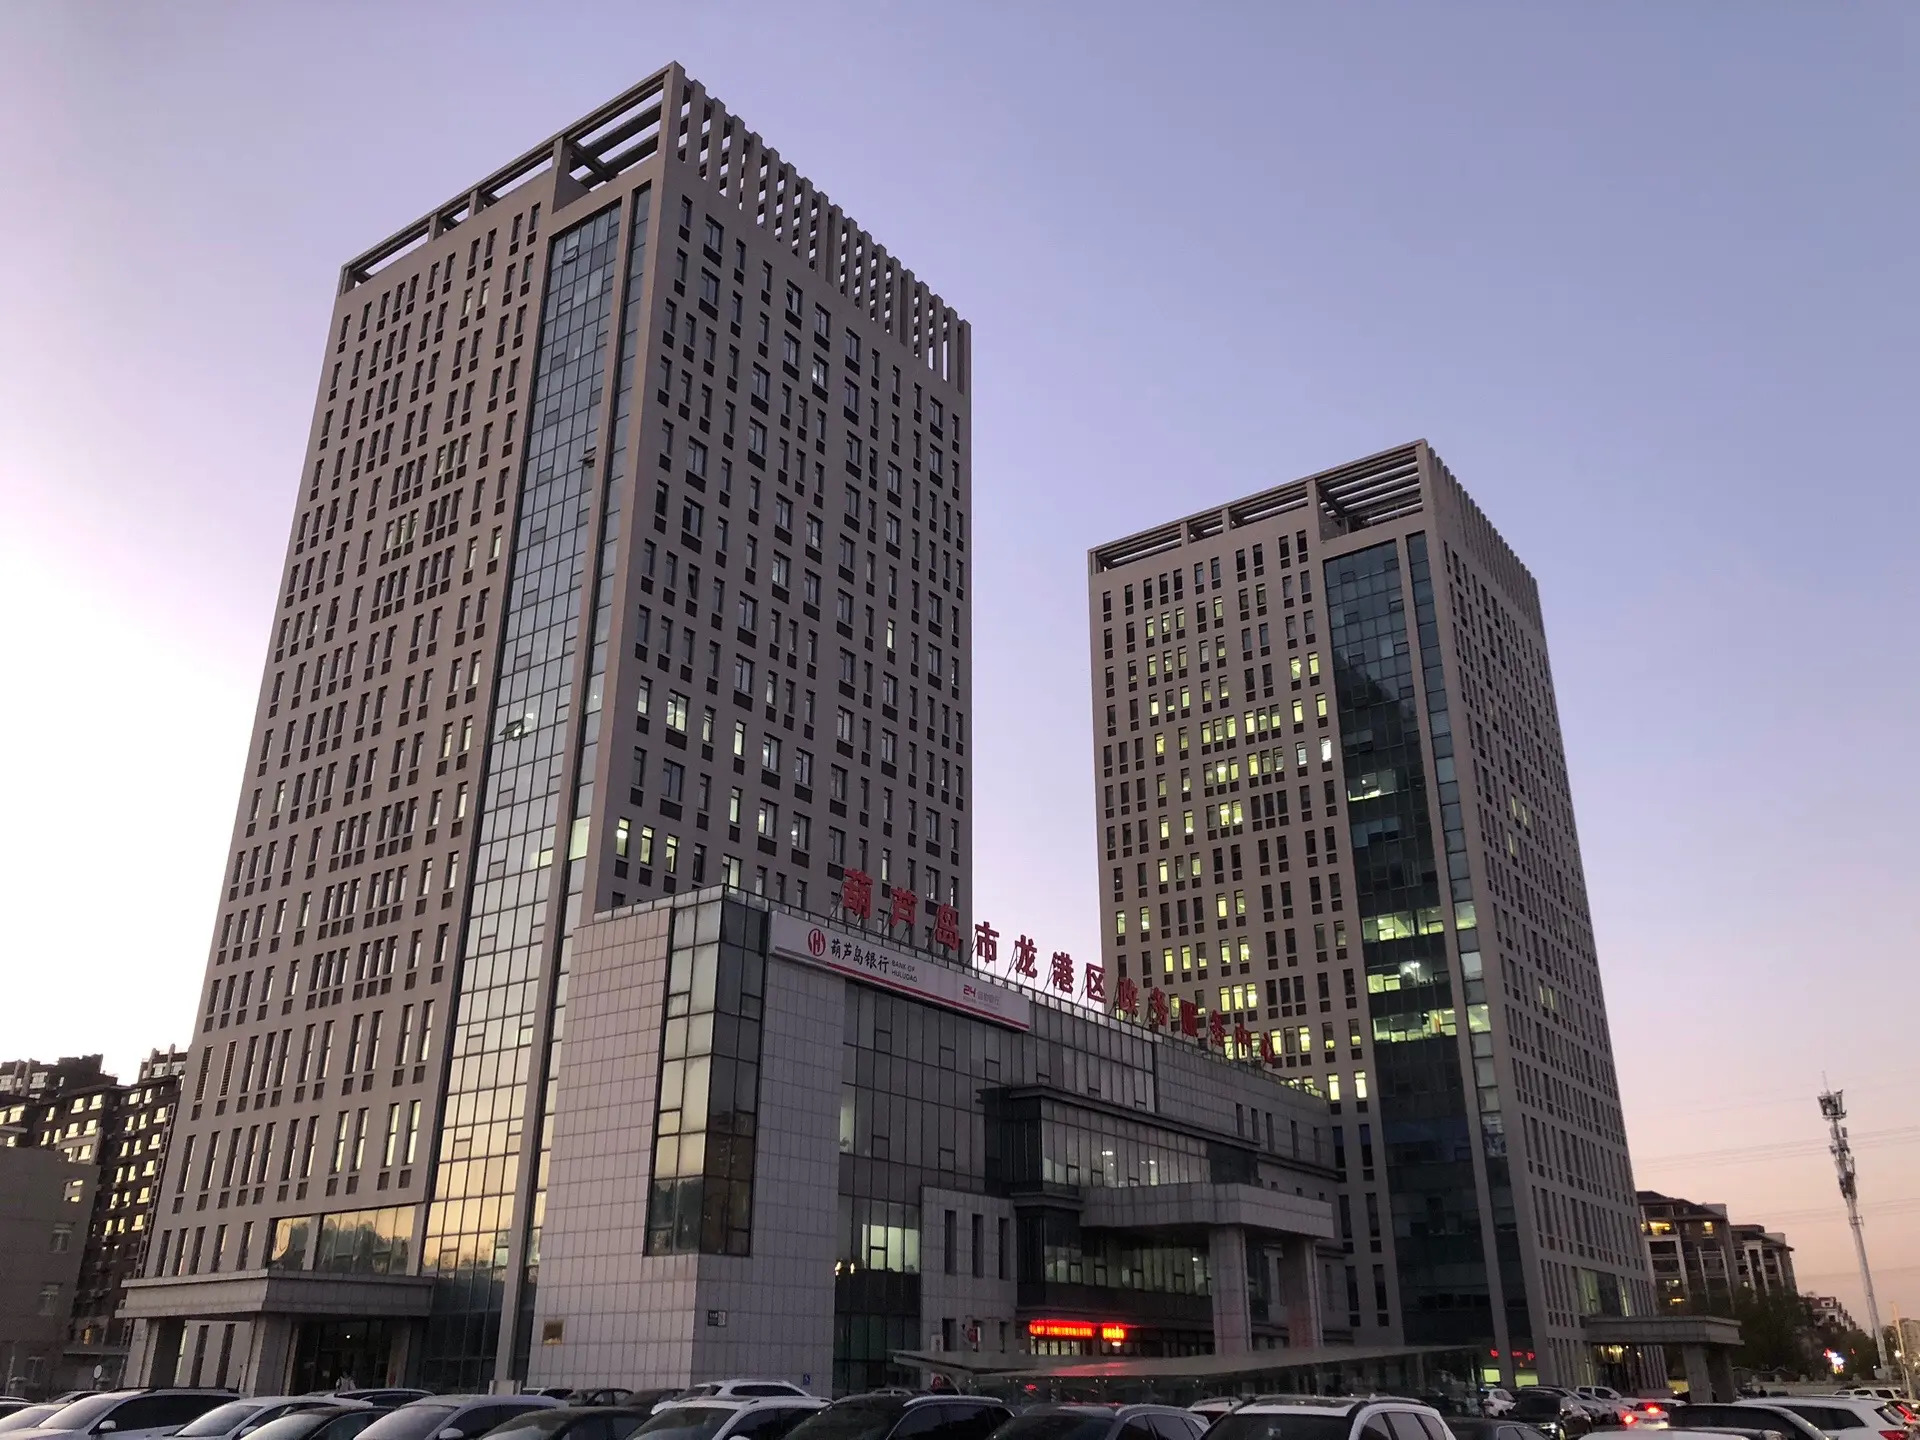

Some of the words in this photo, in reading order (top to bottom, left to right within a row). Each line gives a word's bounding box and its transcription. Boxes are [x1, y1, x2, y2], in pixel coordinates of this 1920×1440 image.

[830, 938, 890, 974] 葫芦岛银行
